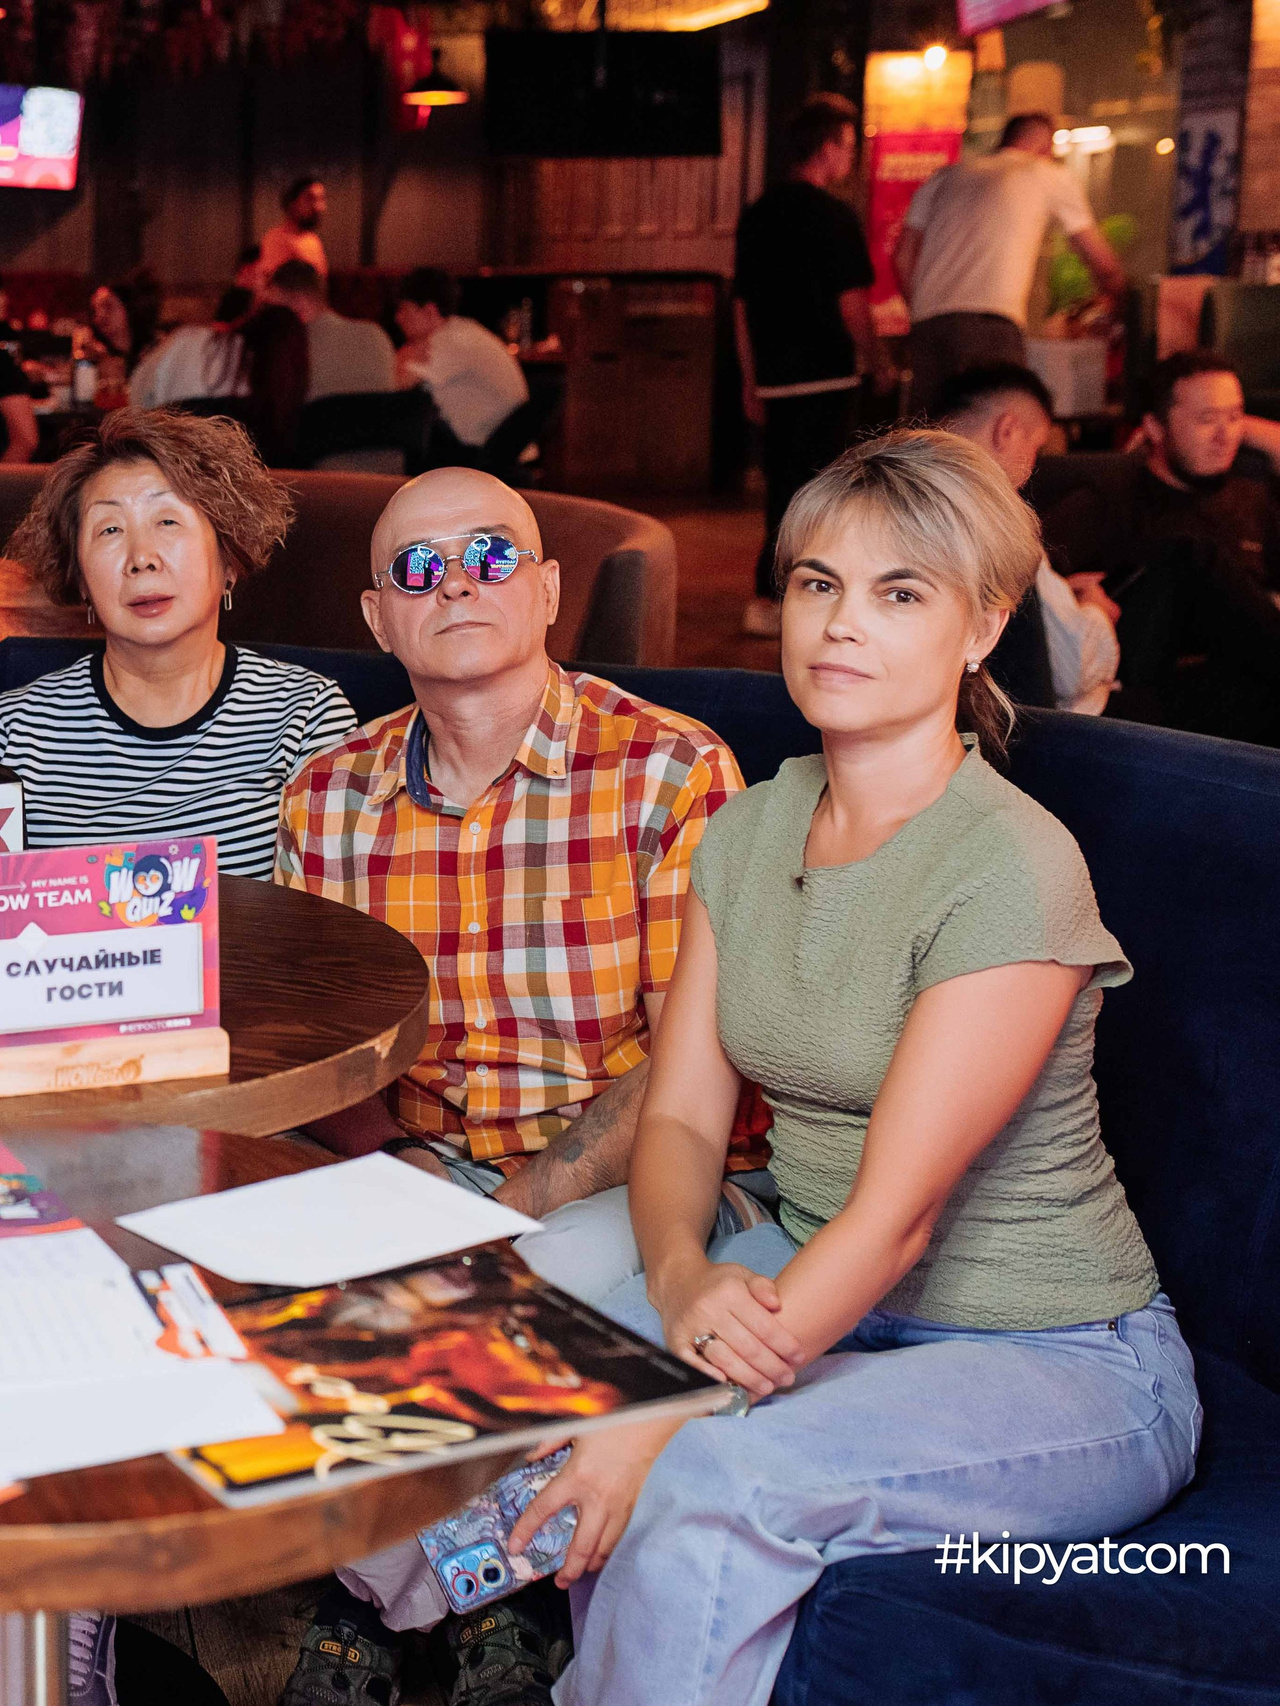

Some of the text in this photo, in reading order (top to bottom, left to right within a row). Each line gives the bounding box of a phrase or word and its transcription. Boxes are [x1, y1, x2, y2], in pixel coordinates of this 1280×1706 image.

[31, 874, 89, 889] MY NAME IS
[33, 887, 93, 909] TEAM
[125, 889, 176, 923] QUIZ
[6, 948, 162, 977] СЛУЧАЙНЫЕ
[46, 981, 124, 1002] ГОСТИ
